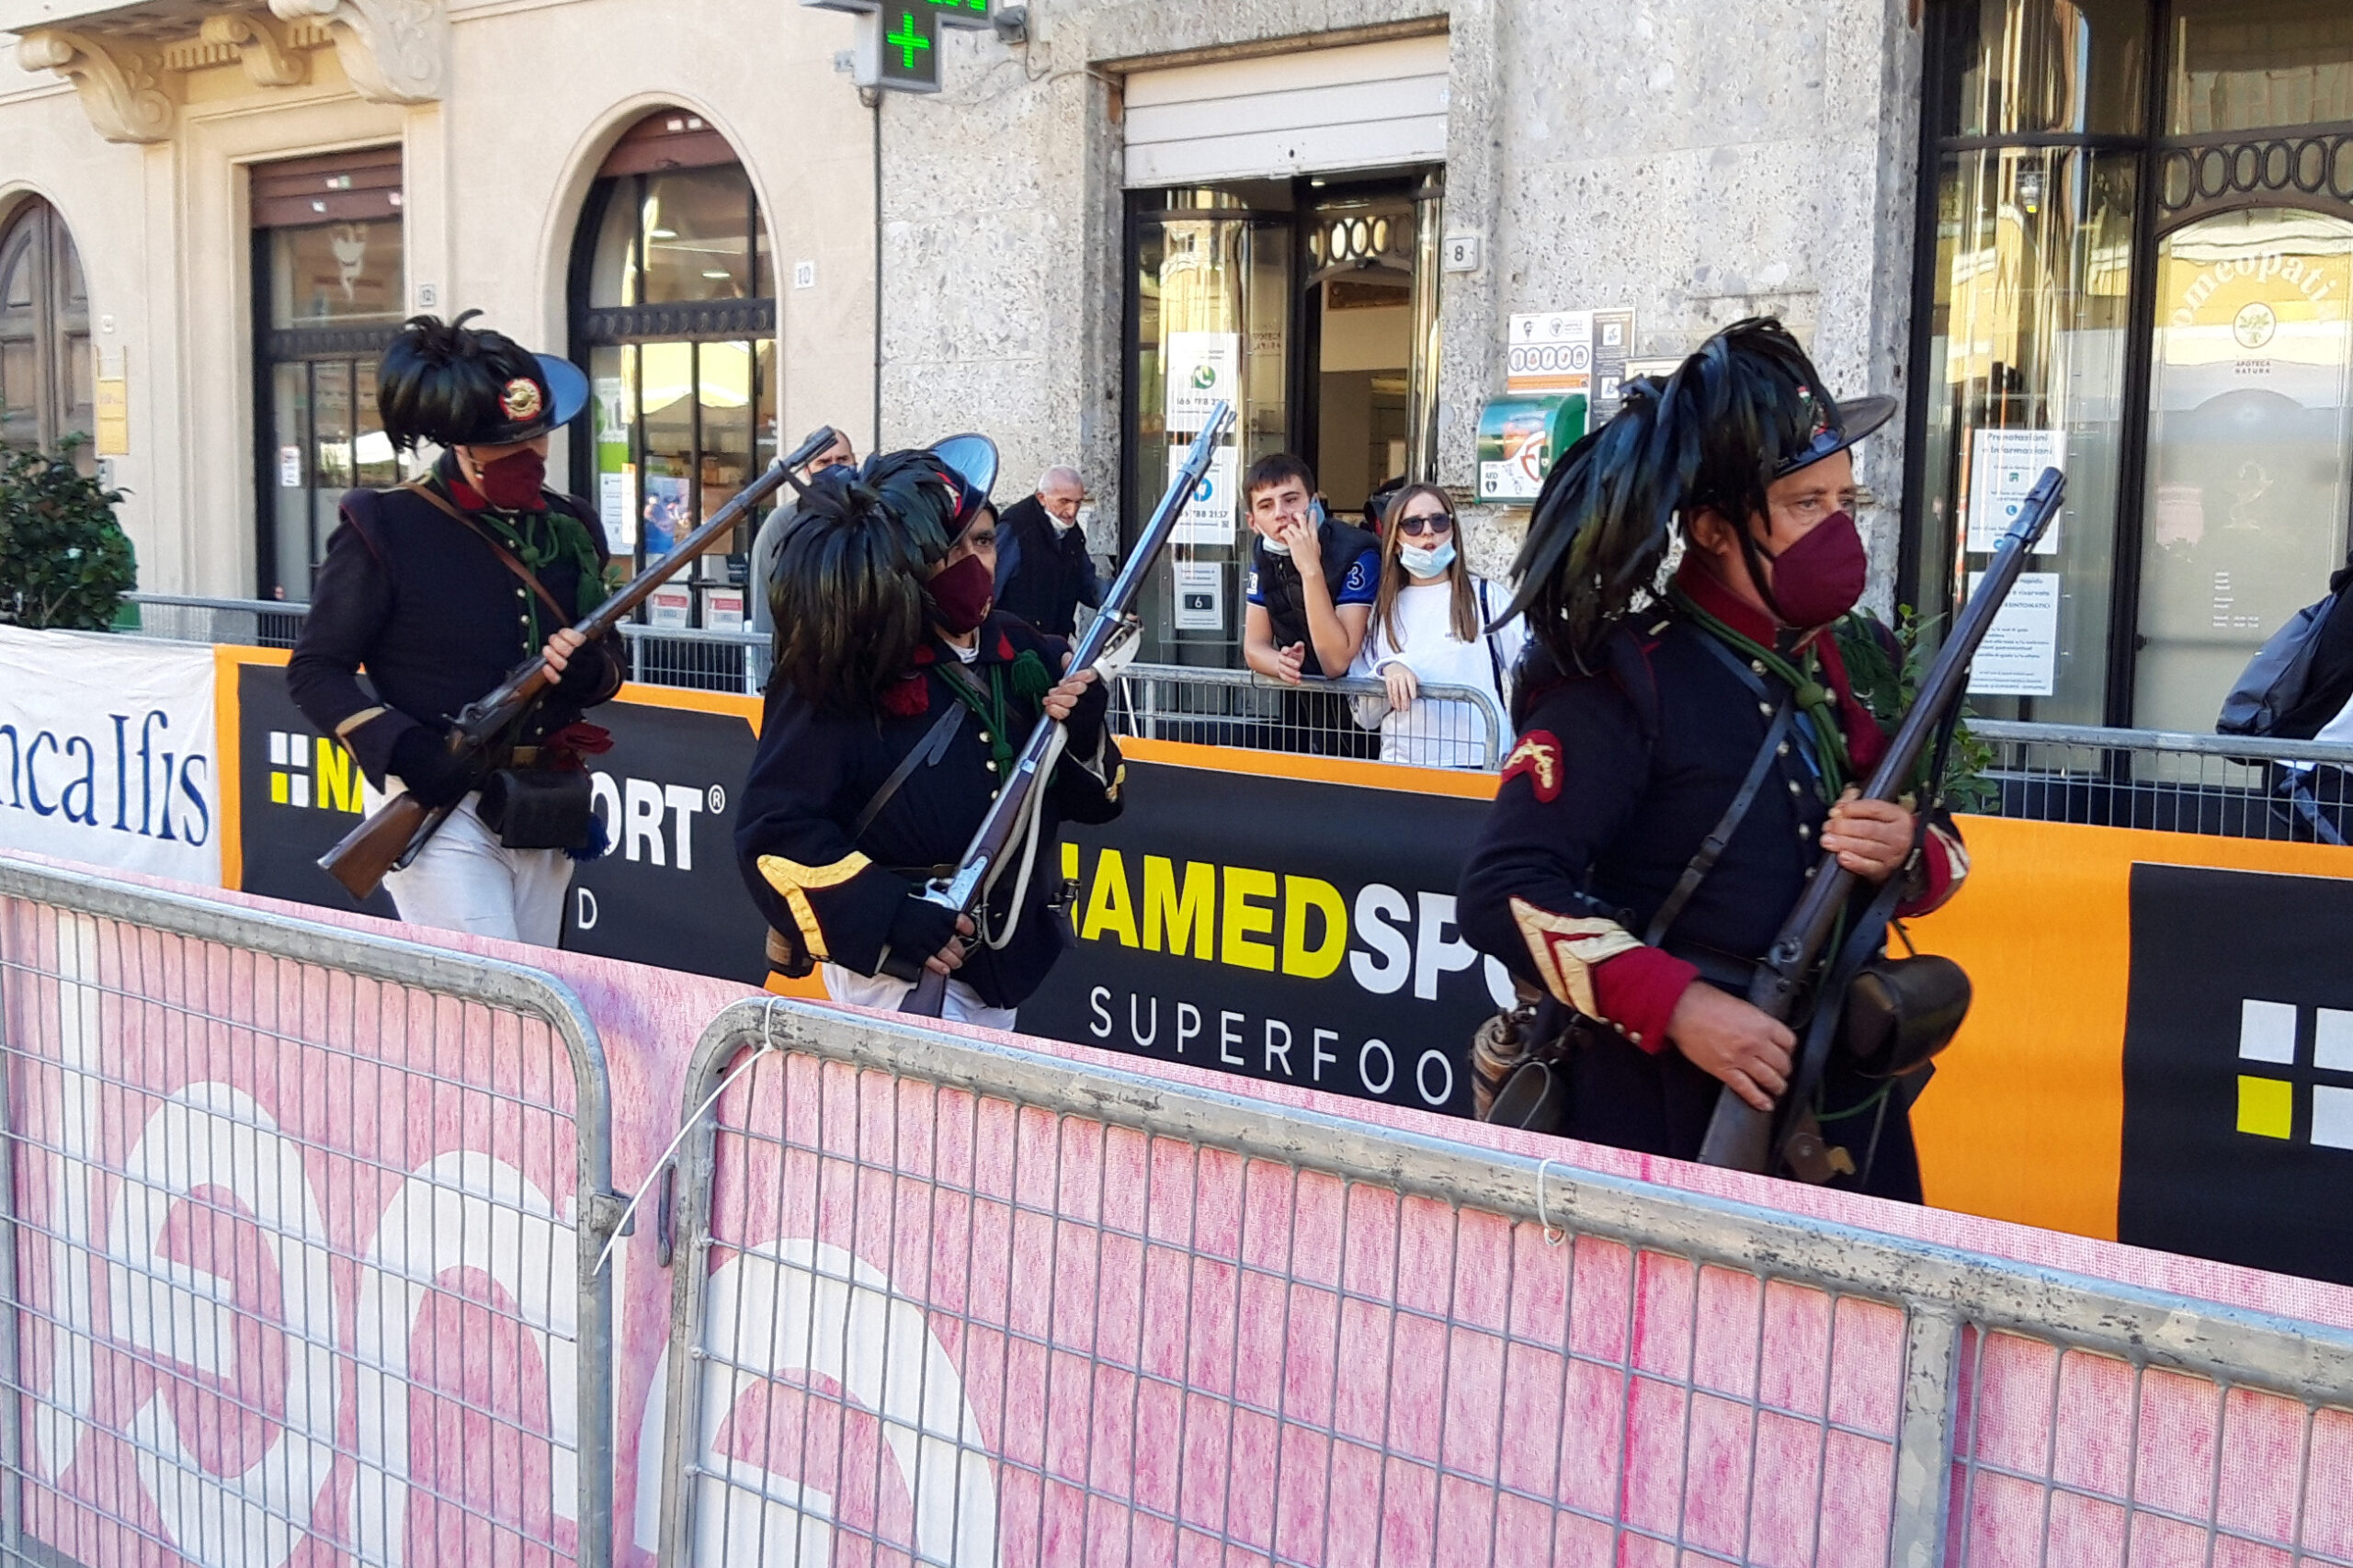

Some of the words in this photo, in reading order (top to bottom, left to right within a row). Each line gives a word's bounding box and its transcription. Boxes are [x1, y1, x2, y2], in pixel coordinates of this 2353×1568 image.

[1454, 244, 1464, 262] 8
[798, 267, 811, 284] 10
[1346, 561, 1366, 591] 3
[1194, 596, 1203, 608] 6
